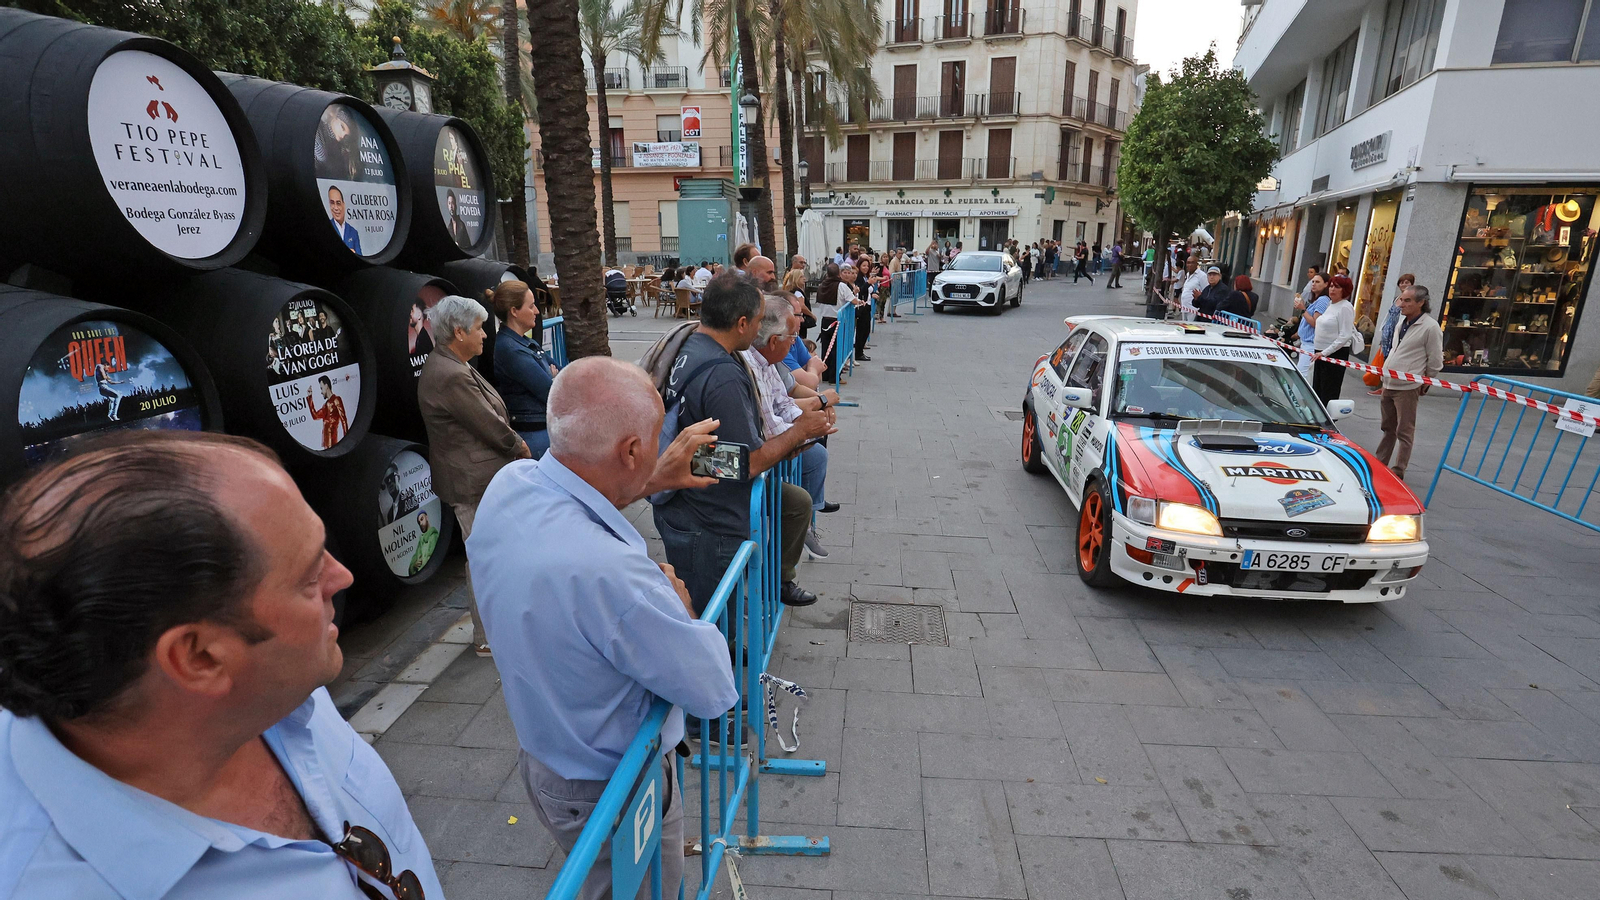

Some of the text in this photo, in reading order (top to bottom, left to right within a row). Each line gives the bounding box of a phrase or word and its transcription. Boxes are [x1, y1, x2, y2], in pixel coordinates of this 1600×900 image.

[120, 122, 210, 148] TIO PEPE
[360, 136, 378, 150] ANA
[360, 150, 384, 164] MENA
[370, 168, 384, 176] JULIO
[448, 162, 466, 176] PHA
[110, 180, 238, 198] veraneaenlabodega.com
[460, 176, 471, 188] EL
[350, 194, 388, 206] GILBERTO
[459, 194, 479, 204] MIGUEL
[833, 196, 846, 206] La
[126, 206, 236, 223] Bodega González Byass
[346, 208, 395, 221] SANTA ROSA
[460, 206, 481, 216] POVEDA
[177, 224, 201, 236] Jerez
[288, 301, 294, 310] 27
[87, 328, 102, 338] SAVE
[278, 337, 338, 360] LA OREJA DE
[1146, 347, 1184, 355] ESCUDERIA
[1186, 347, 1218, 356] PONIENTE
[1230, 350, 1262, 360] GRANADA
[68, 336, 128, 382] QUEEN
[282, 352, 338, 376] VAN GOGH
[275, 383, 300, 400] LUIS
[139, 395, 177, 411] 20 JULIO
[275, 398, 307, 416] FONSI
[288, 414, 306, 428] JULIO
[1259, 444, 1295, 454] rd
[408, 464, 424, 476] AGOSTO
[1226, 467, 1324, 480] MARTINI
[401, 476, 432, 500] SANTIAGO
[392, 524, 405, 538] NIL
[384, 530, 417, 556] MOLINER
[396, 546, 414, 562] AGOSTO
[1251, 553, 1260, 567] A
[1267, 554, 1311, 570] 6285
[1322, 556, 1345, 571] CF
